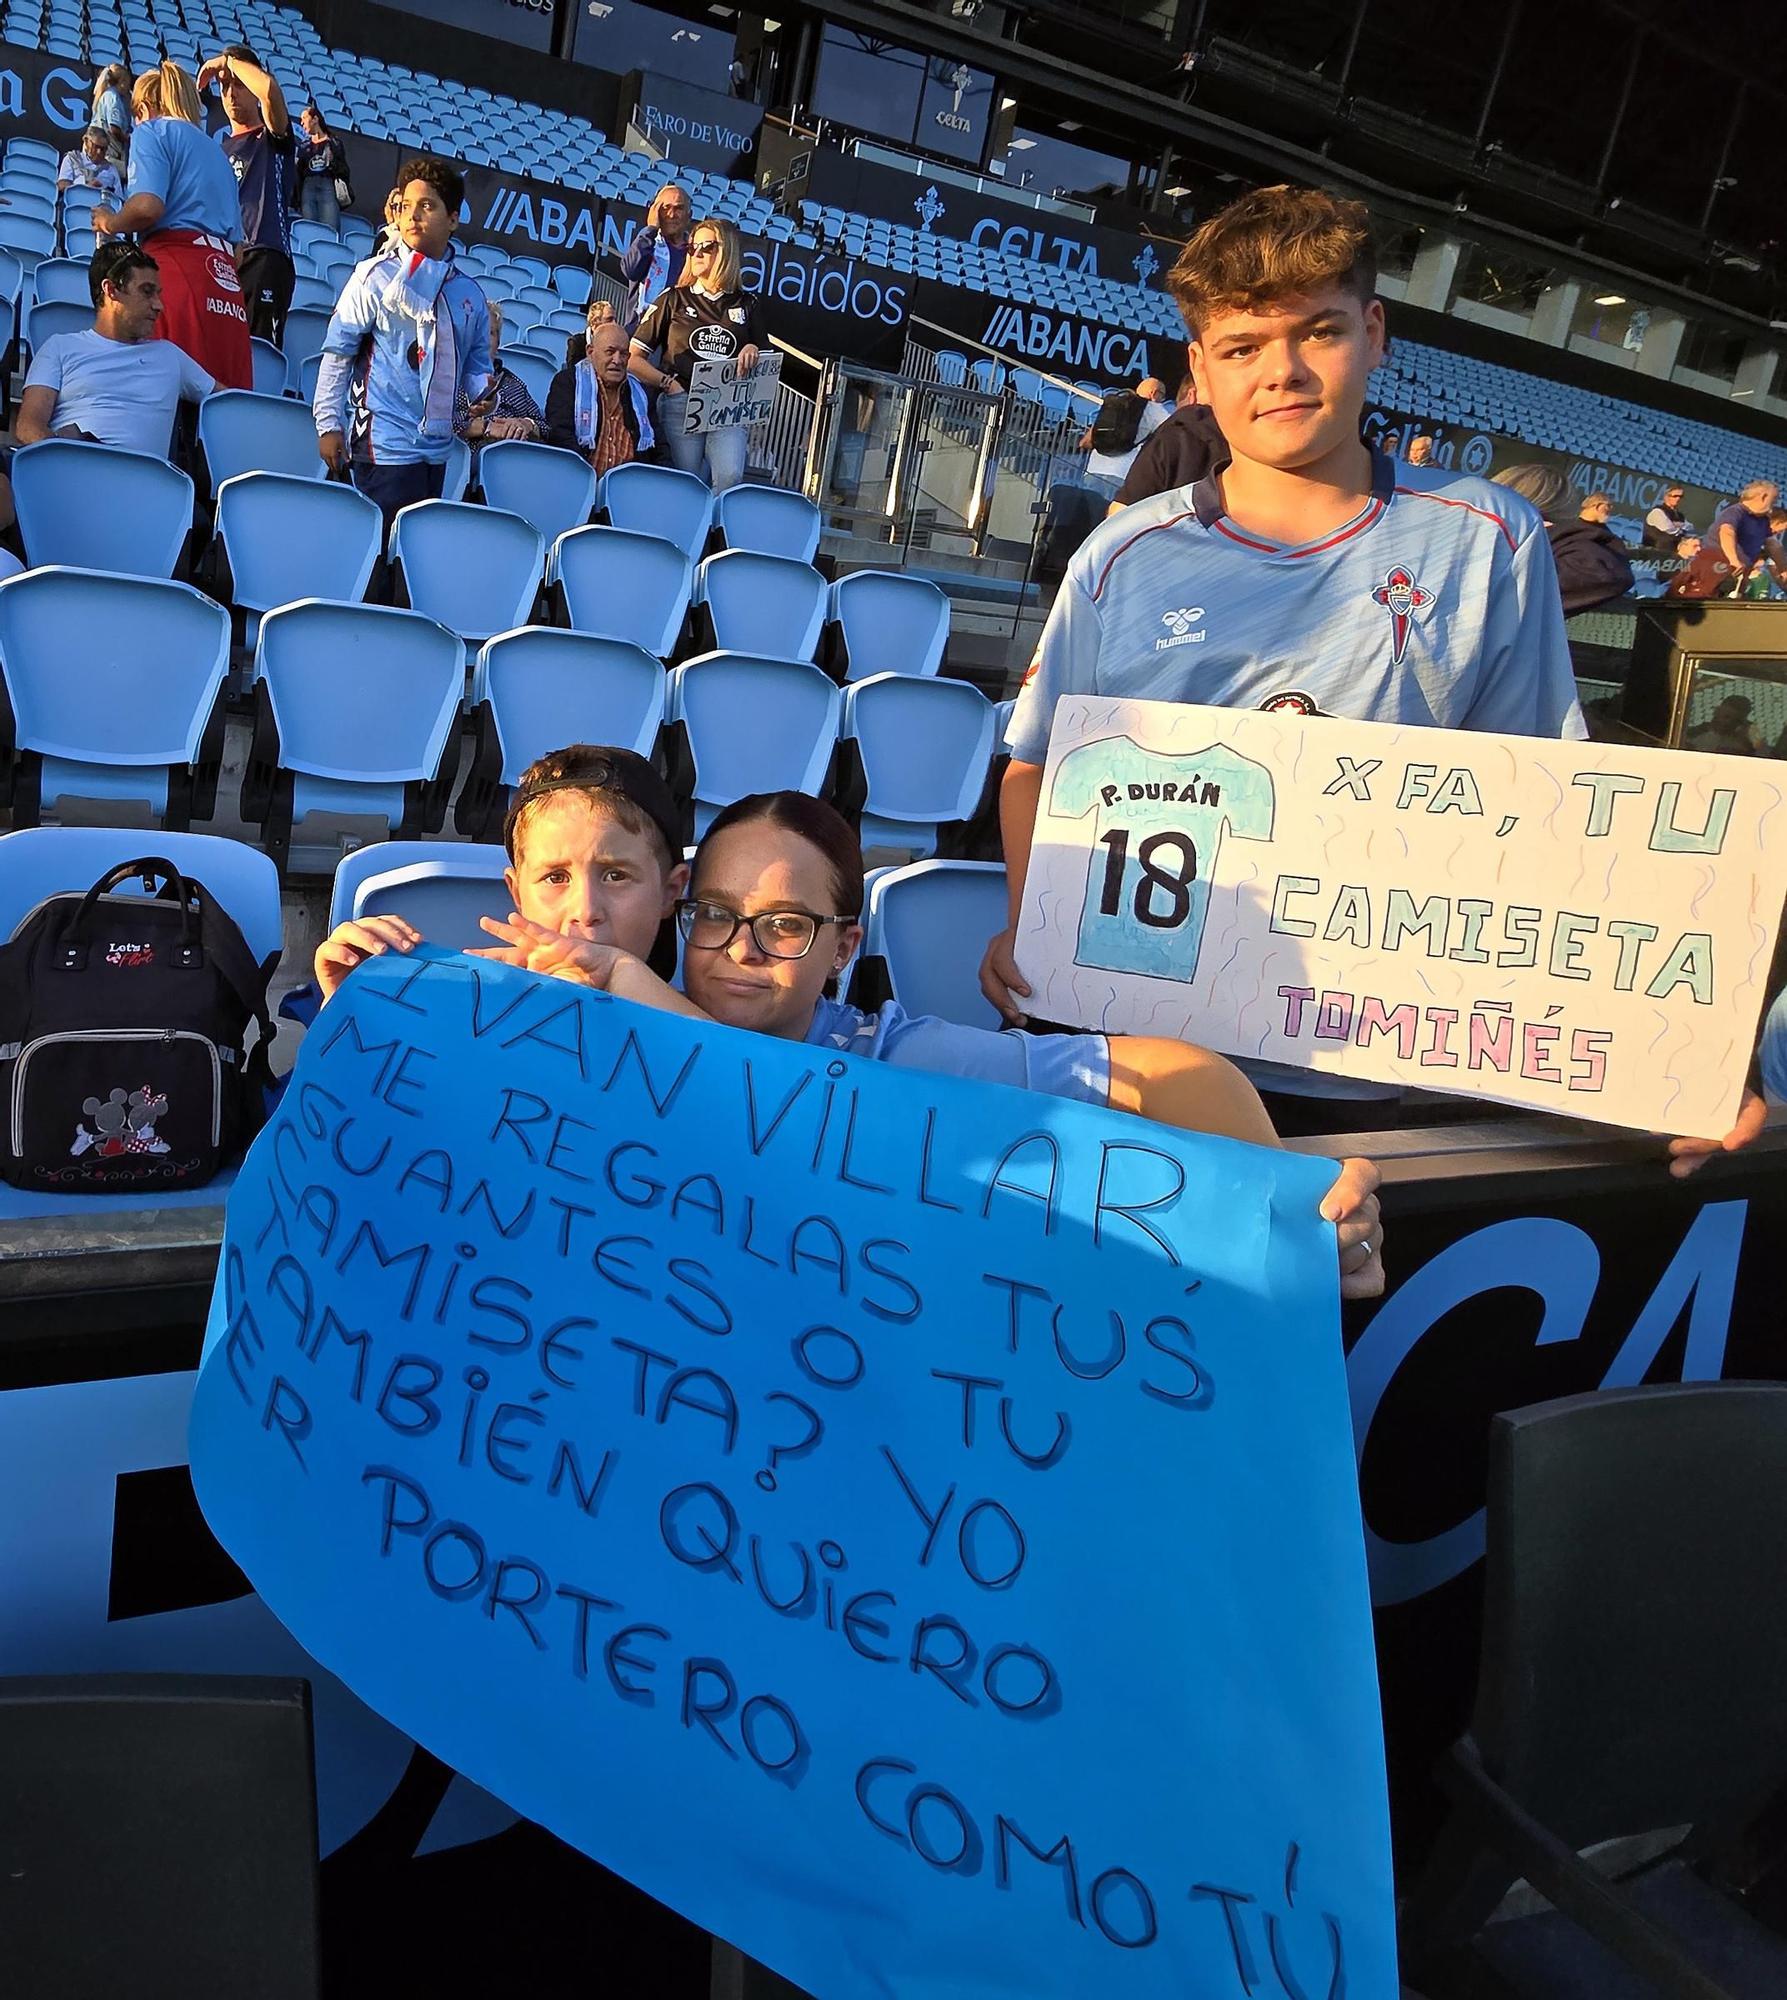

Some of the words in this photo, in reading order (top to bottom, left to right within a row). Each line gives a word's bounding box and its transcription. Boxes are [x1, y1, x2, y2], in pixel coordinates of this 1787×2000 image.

[645, 105, 687, 135] FARO
[689, 121, 712, 143] DE
[714, 124, 753, 154] VIGO
[936, 111, 971, 133] CELTA
[740, 240, 908, 326] alaídos
[698, 331, 731, 345] Estrella
[698, 342, 727, 354] Galicia
[1155, 629, 1206, 651] hummel
[1128, 773, 1221, 807] DURÁN
[1322, 756, 1383, 801] X
[1571, 772, 1738, 855] TU
[1099, 828, 1198, 929] 18
[1269, 874, 1714, 1005] CAMISETA
[1277, 985, 1613, 1093] TOMIÑÉS
[320, 1015, 438, 1119] ME
[488, 1088, 922, 1321] REGALAS
[301, 1082, 733, 1336] GUANTES
[795, 1324, 866, 1390] O
[932, 1368, 1070, 1471] TU
[880, 1444, 1026, 1588] YO
[362, 1463, 811, 1789] PORTERO
[855, 1756, 1157, 1948] COMO
[1190, 1841, 1346, 2000] TÚ
